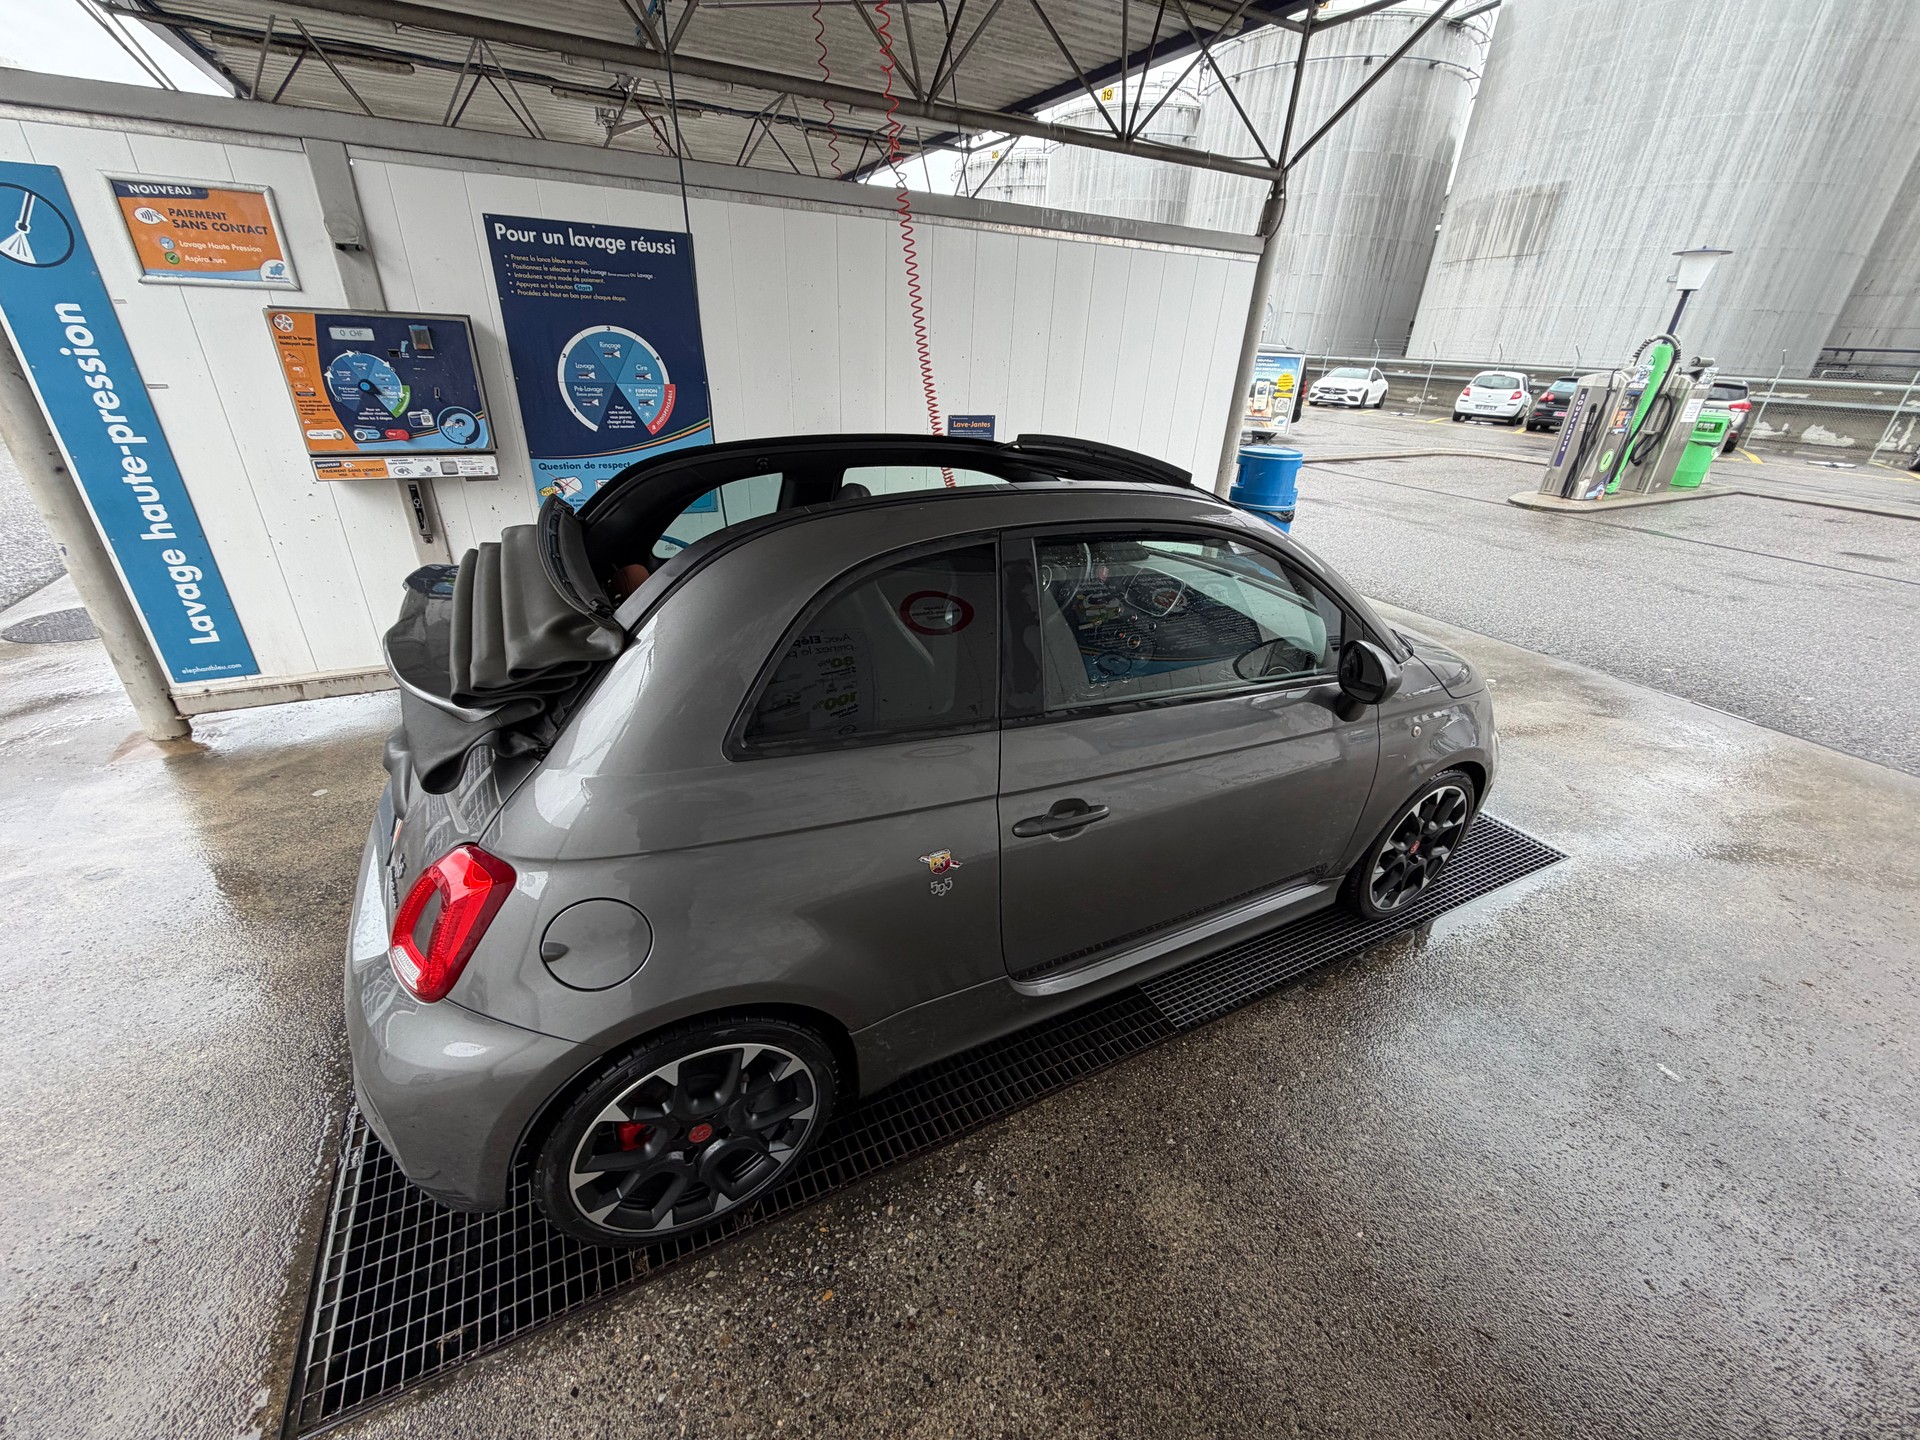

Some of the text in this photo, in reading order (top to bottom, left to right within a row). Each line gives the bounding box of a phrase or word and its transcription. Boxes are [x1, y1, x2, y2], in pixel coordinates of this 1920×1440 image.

[1102, 89, 1113, 101] 19
[128, 184, 192, 196] NOUVEAU
[168, 208, 227, 221] PAIEMENT
[173, 219, 268, 236] SANS CONTACT
[494, 222, 676, 255] Pour un lavage réussi
[179, 240, 262, 253] Lavage Haute Pression
[511, 253, 529, 261] Prenez
[536, 255, 551, 263] lance
[552, 256, 566, 264] bleue
[512, 262, 542, 271] Positionnez
[580, 267, 607, 276] Pré-Lavage
[637, 272, 653, 280] Lavage
[555, 282, 573, 290] bouton
[517, 288, 541, 297] Procédez
[550, 290, 562, 298] haut
[570, 291, 579, 299] bas
[593, 293, 612, 302] chaque
[599, 341, 621, 350] Rinçage
[575, 362, 595, 370] Lavage
[574, 385, 603, 393] Pré-Lavage
[953, 420, 991, 428] Lave-Jantes
[1561, 394, 1585, 452] SOUFFLETTE
[538, 461, 581, 471] Question
[598, 461, 631, 470] respect
[55, 302, 221, 645] Lavage haute-pression
[182, 663, 242, 674] elephantbleu.com
[930, 877, 953, 896] 595
